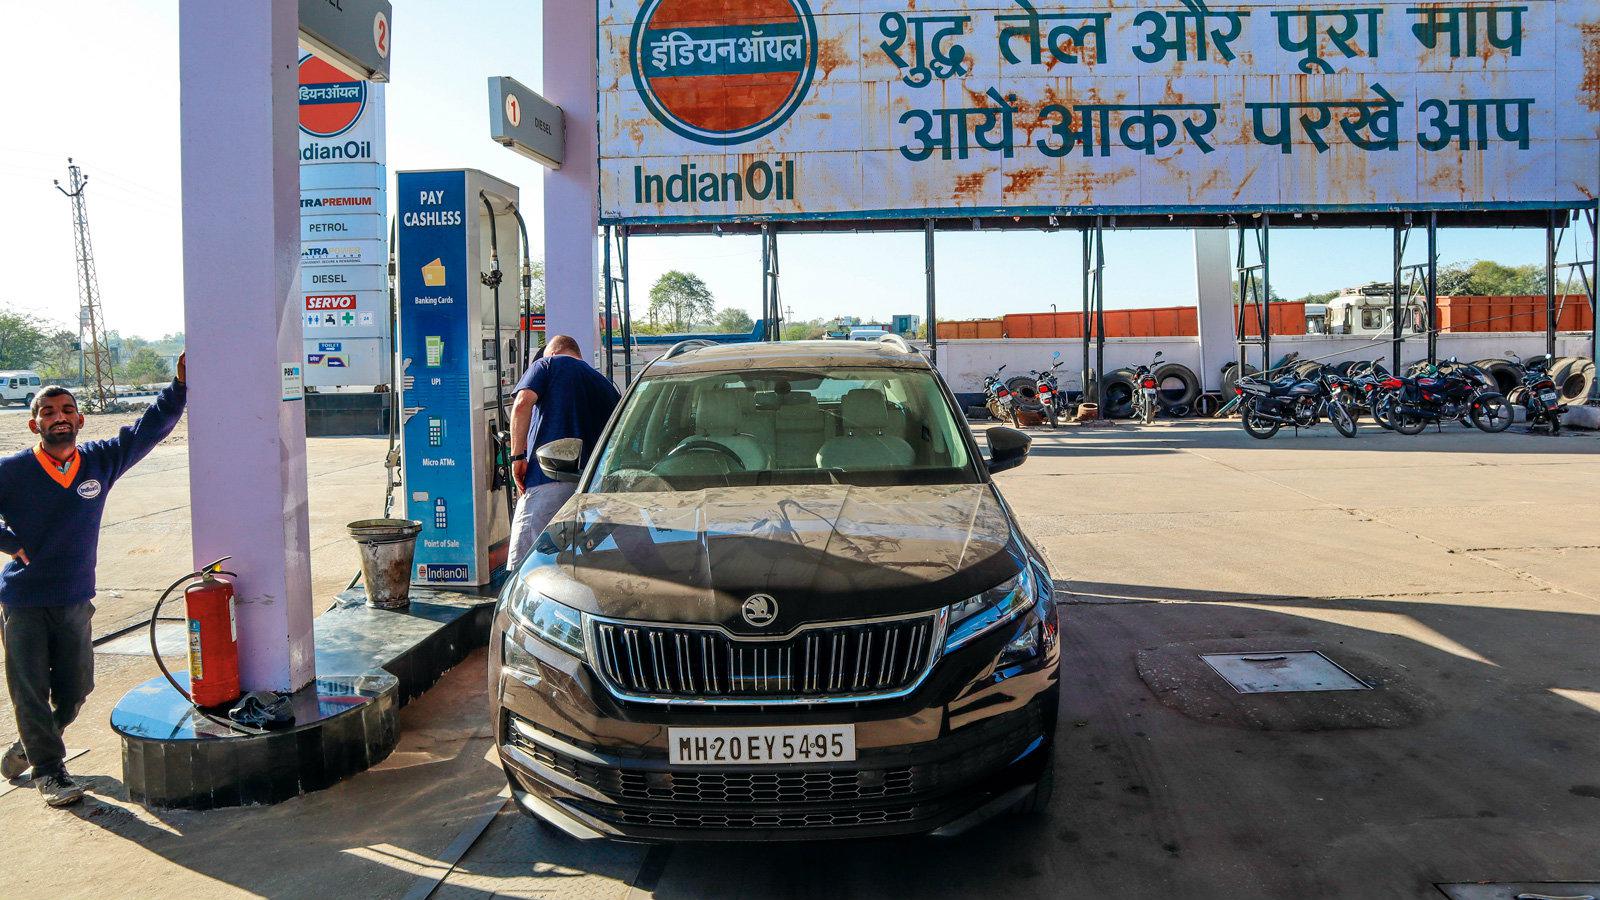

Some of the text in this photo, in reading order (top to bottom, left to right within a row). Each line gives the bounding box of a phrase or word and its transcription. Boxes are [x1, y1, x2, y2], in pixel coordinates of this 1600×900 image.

[379, 20, 385, 51] 2
[878, 0, 1527, 87] शुद्ध तेल और पूरा माप
[650, 31, 804, 71] इंडियनऑयल
[299, 85, 359, 101] डियनऑयल
[511, 101, 516, 123] 1
[534, 117, 552, 136] DIESEL
[899, 84, 1535, 161] आयें आकर परखे आप
[299, 141, 371, 161] dianOil
[635, 160, 794, 203] IndianOil
[300, 197, 371, 207] TRAPREMIUM
[420, 190, 445, 205] PAY
[403, 211, 462, 227] CASHLESS
[309, 223, 348, 232] PETROL
[312, 274, 347, 284] DIESEL
[308, 297, 350, 308] SERVO
[415, 296, 453, 305] Banking Cards
[423, 458, 455, 466] Micro ATMs
[424, 540, 460, 548] Point of Sale
[428, 568, 467, 579] IndianOil
[679, 733, 843, 761] MH20EY5495
